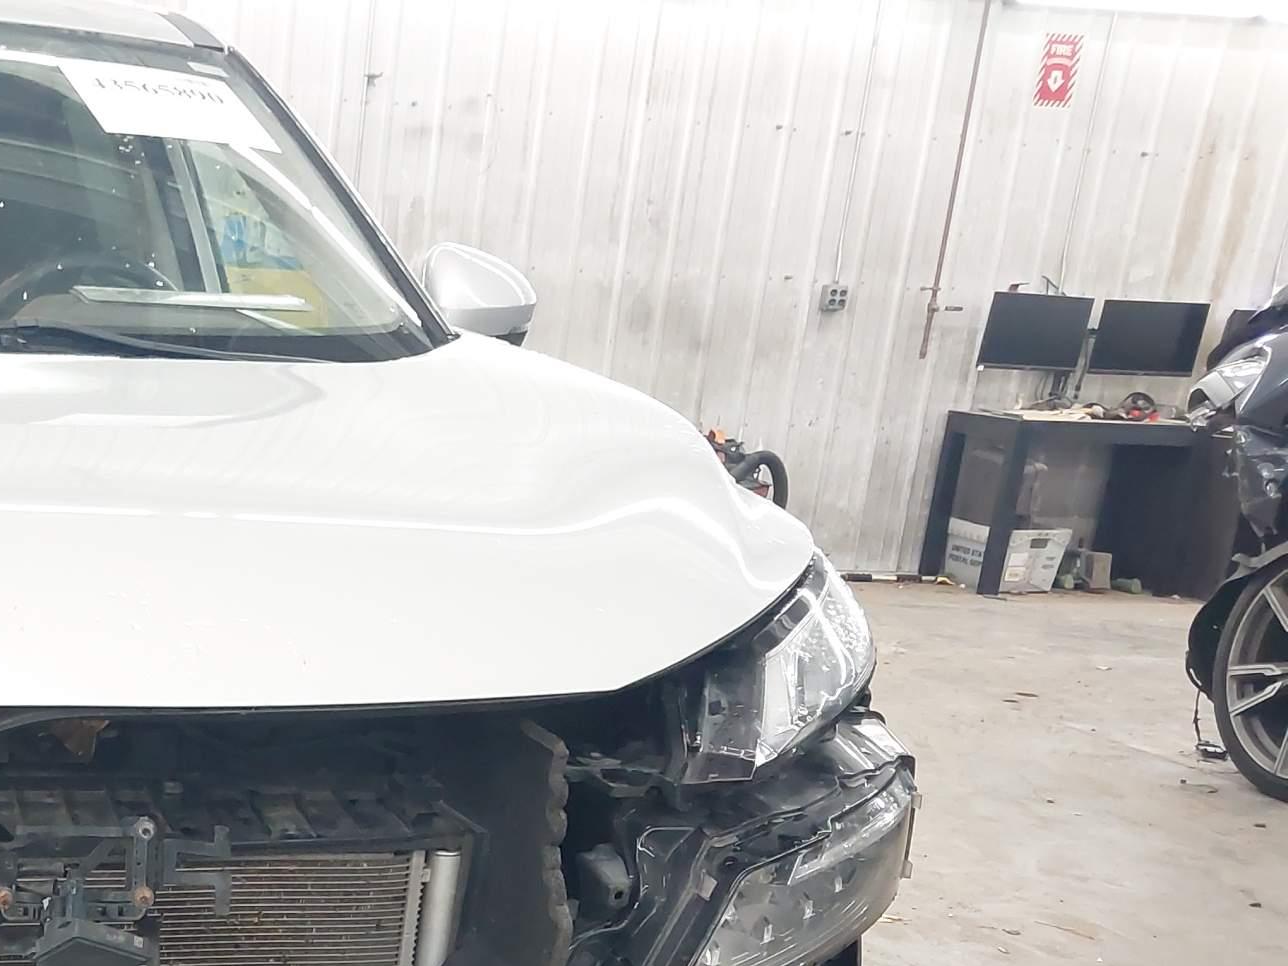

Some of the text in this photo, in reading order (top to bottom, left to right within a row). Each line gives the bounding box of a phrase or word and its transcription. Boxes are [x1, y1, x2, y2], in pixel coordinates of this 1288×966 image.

[1050, 44, 1075, 57] FIRE
[951, 544, 971, 555] UNITED
[948, 553, 969, 565] POSTAL
